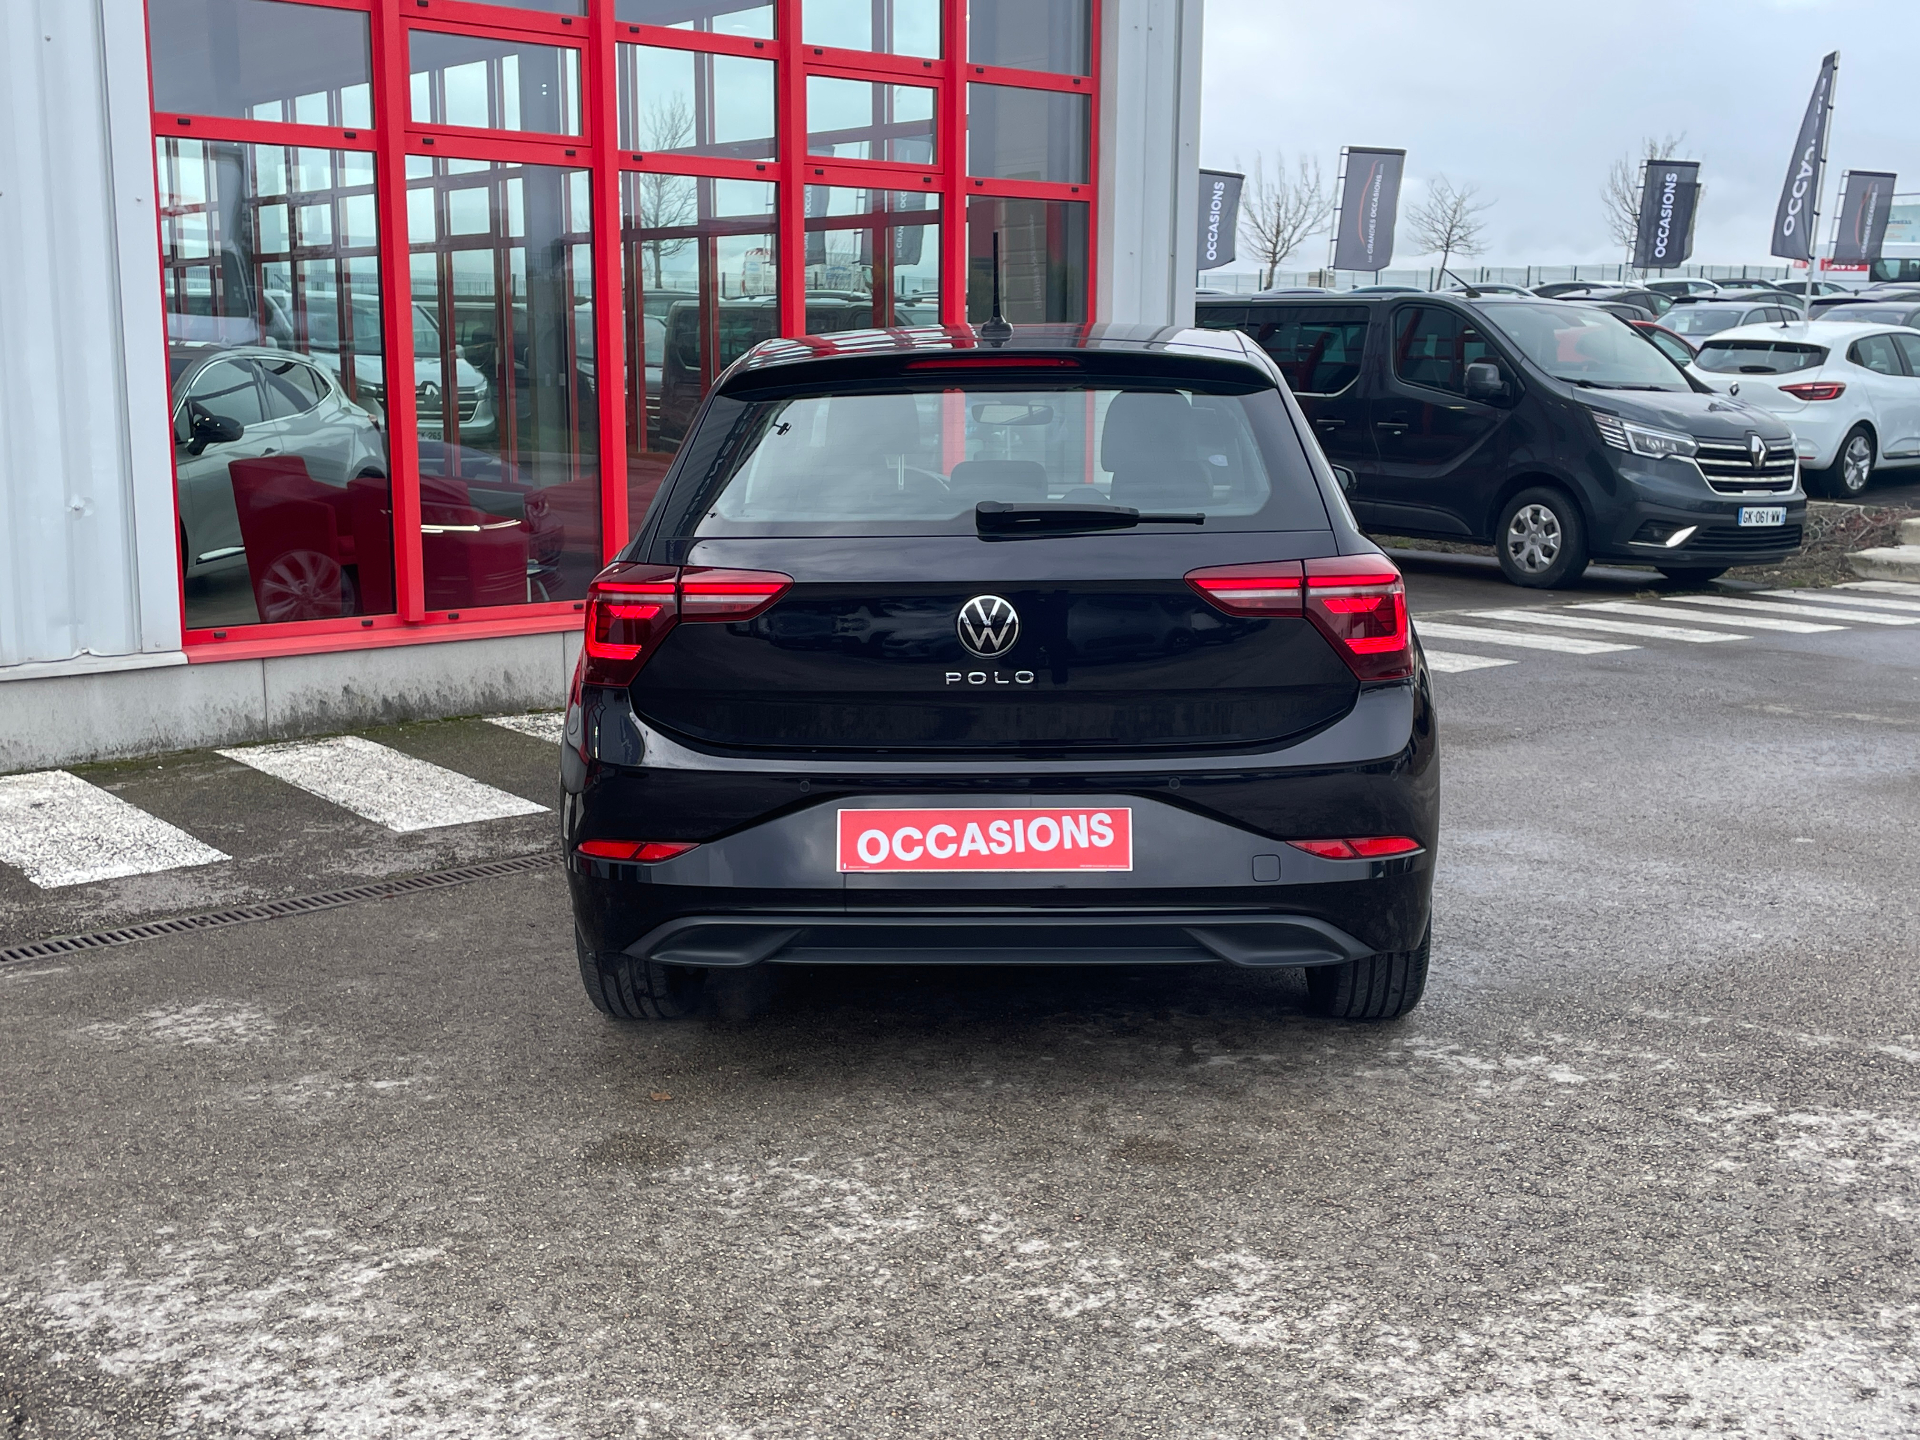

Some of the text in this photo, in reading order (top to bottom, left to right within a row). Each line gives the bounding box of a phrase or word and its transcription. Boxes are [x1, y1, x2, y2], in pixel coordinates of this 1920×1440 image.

[1206, 181, 1225, 260] OCCASIONS
[1367, 219, 1377, 254] GRANDES
[1655, 173, 1677, 258] OCCASIONS
[945, 670, 1035, 685] POLO
[857, 812, 1115, 864] OCCASIONS
